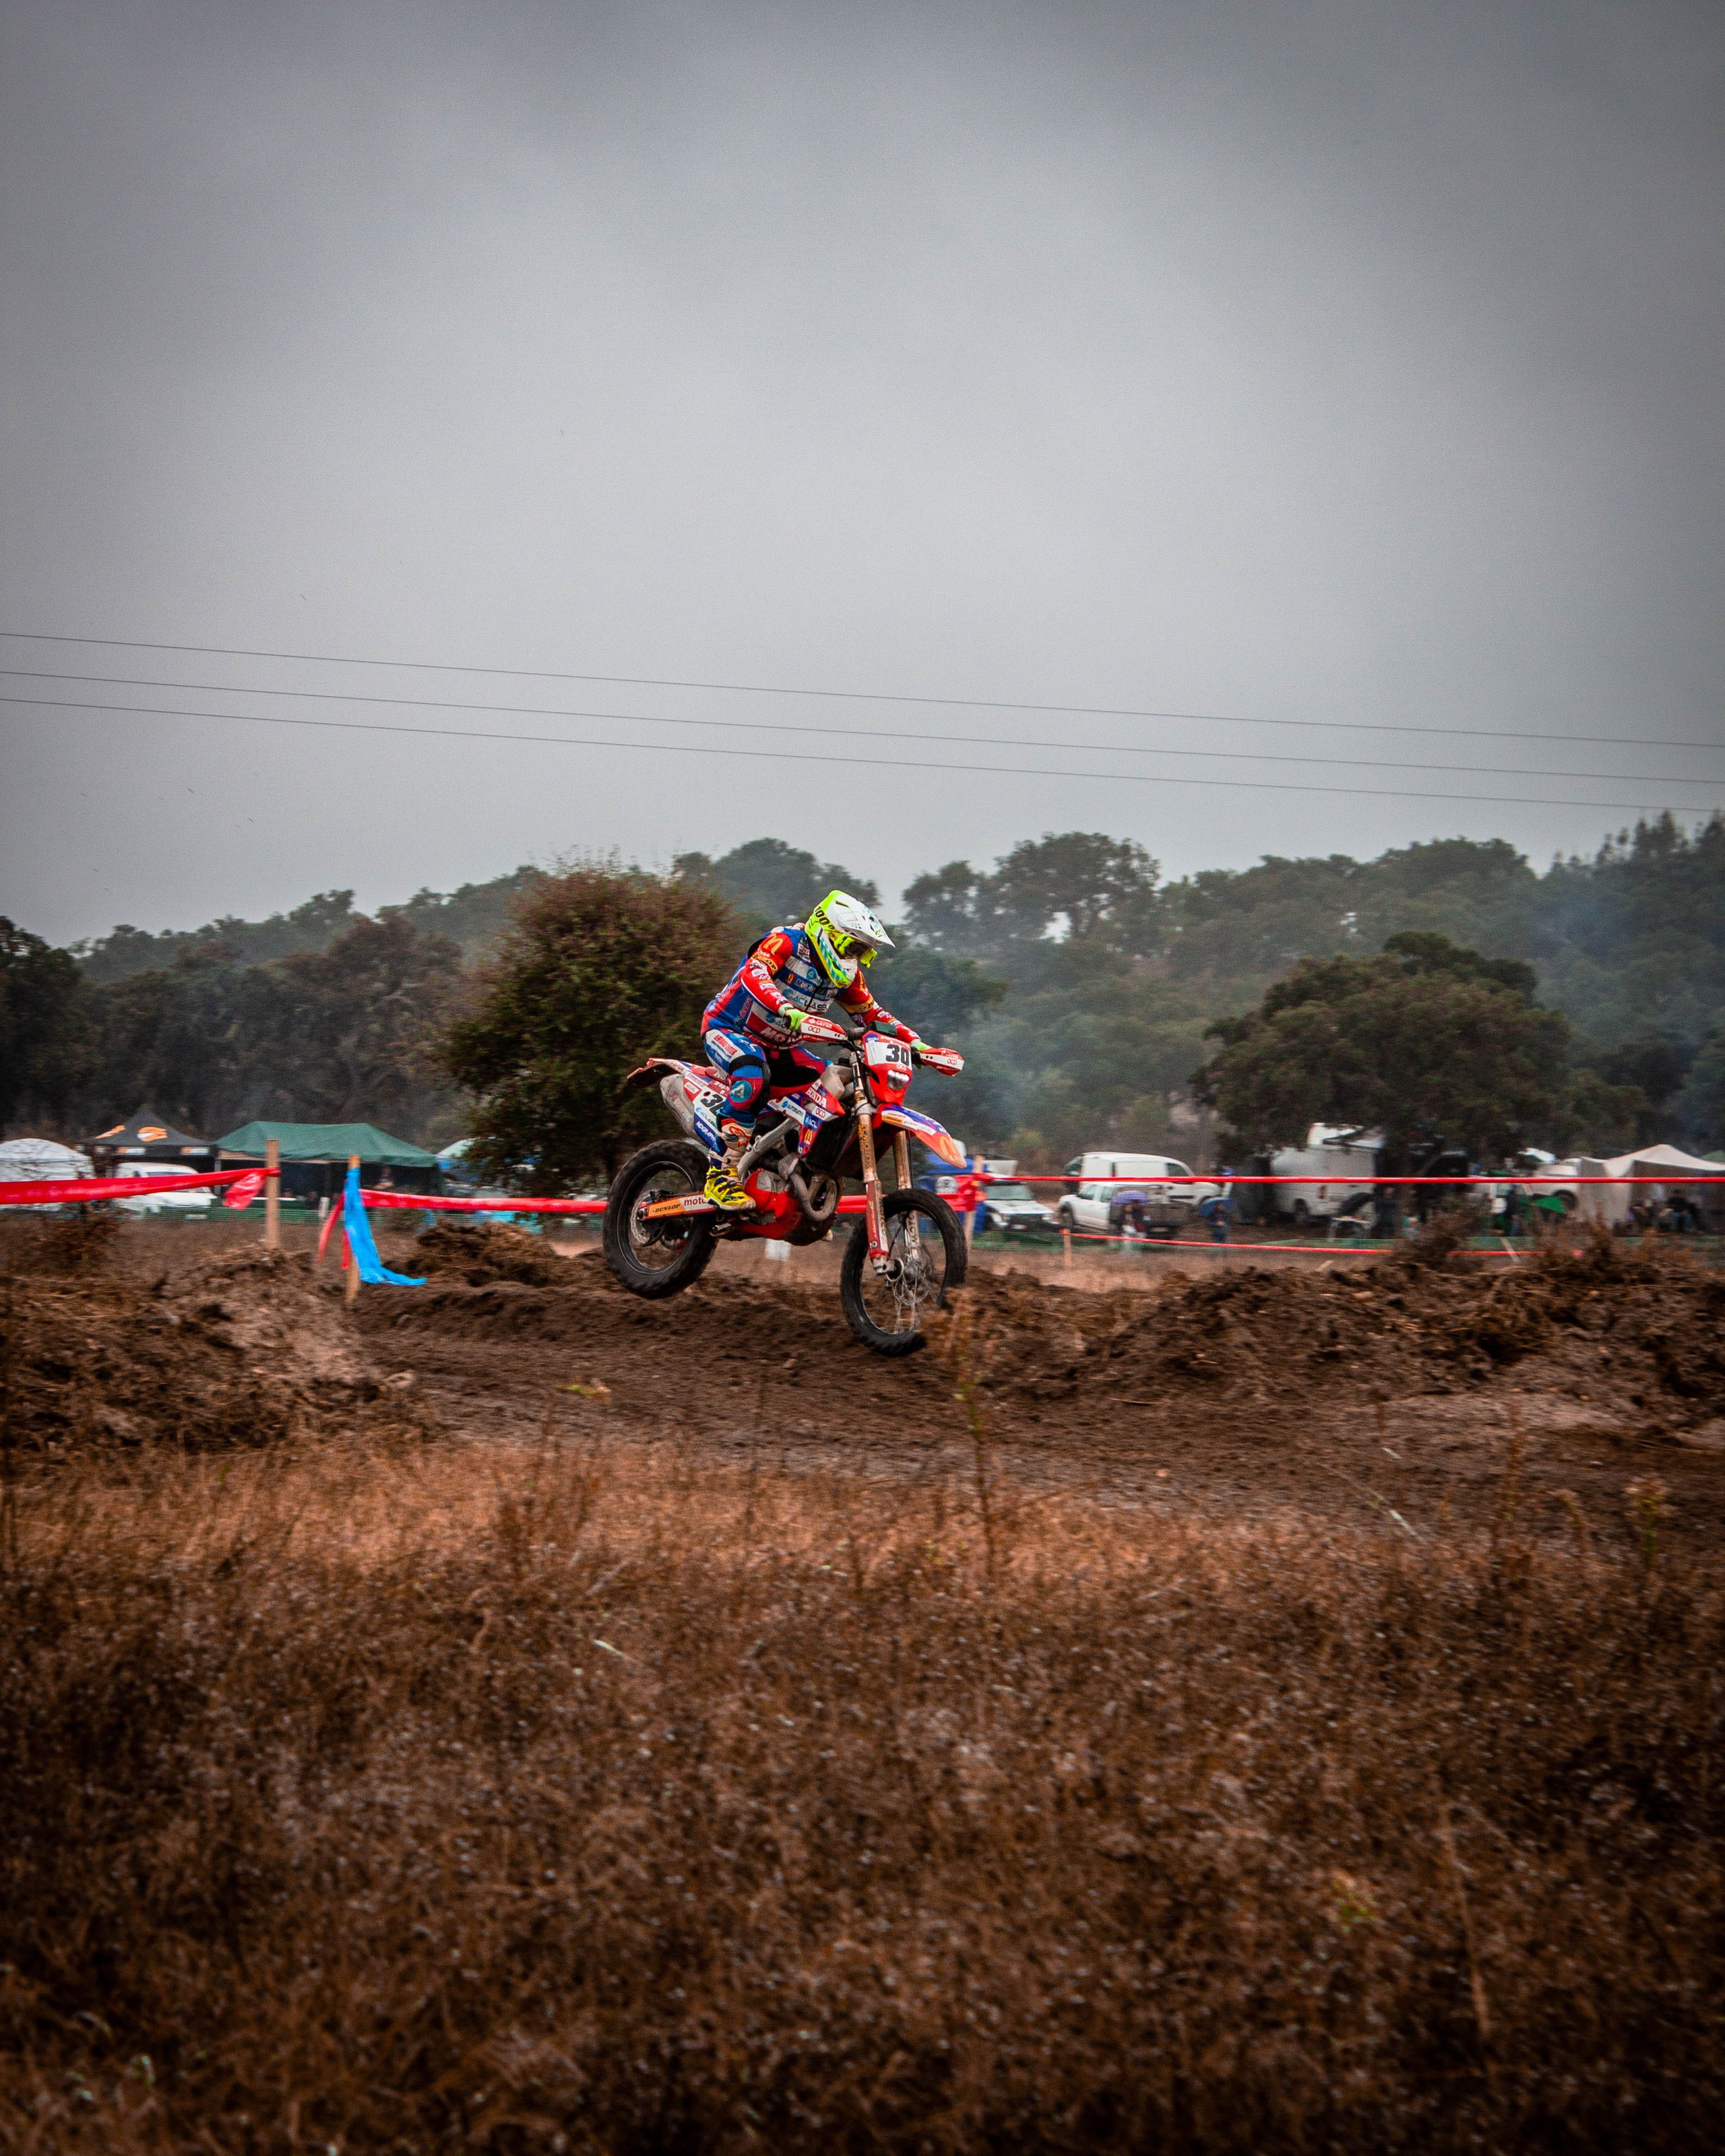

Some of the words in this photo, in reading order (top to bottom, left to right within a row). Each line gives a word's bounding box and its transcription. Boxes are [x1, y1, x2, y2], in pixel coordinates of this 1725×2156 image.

[816, 1019, 833, 1028] CEPSA
[885, 1044, 910, 1067] 30
[805, 1087, 827, 1109] HONDA
[655, 1203, 682, 1213] DUNLOP
